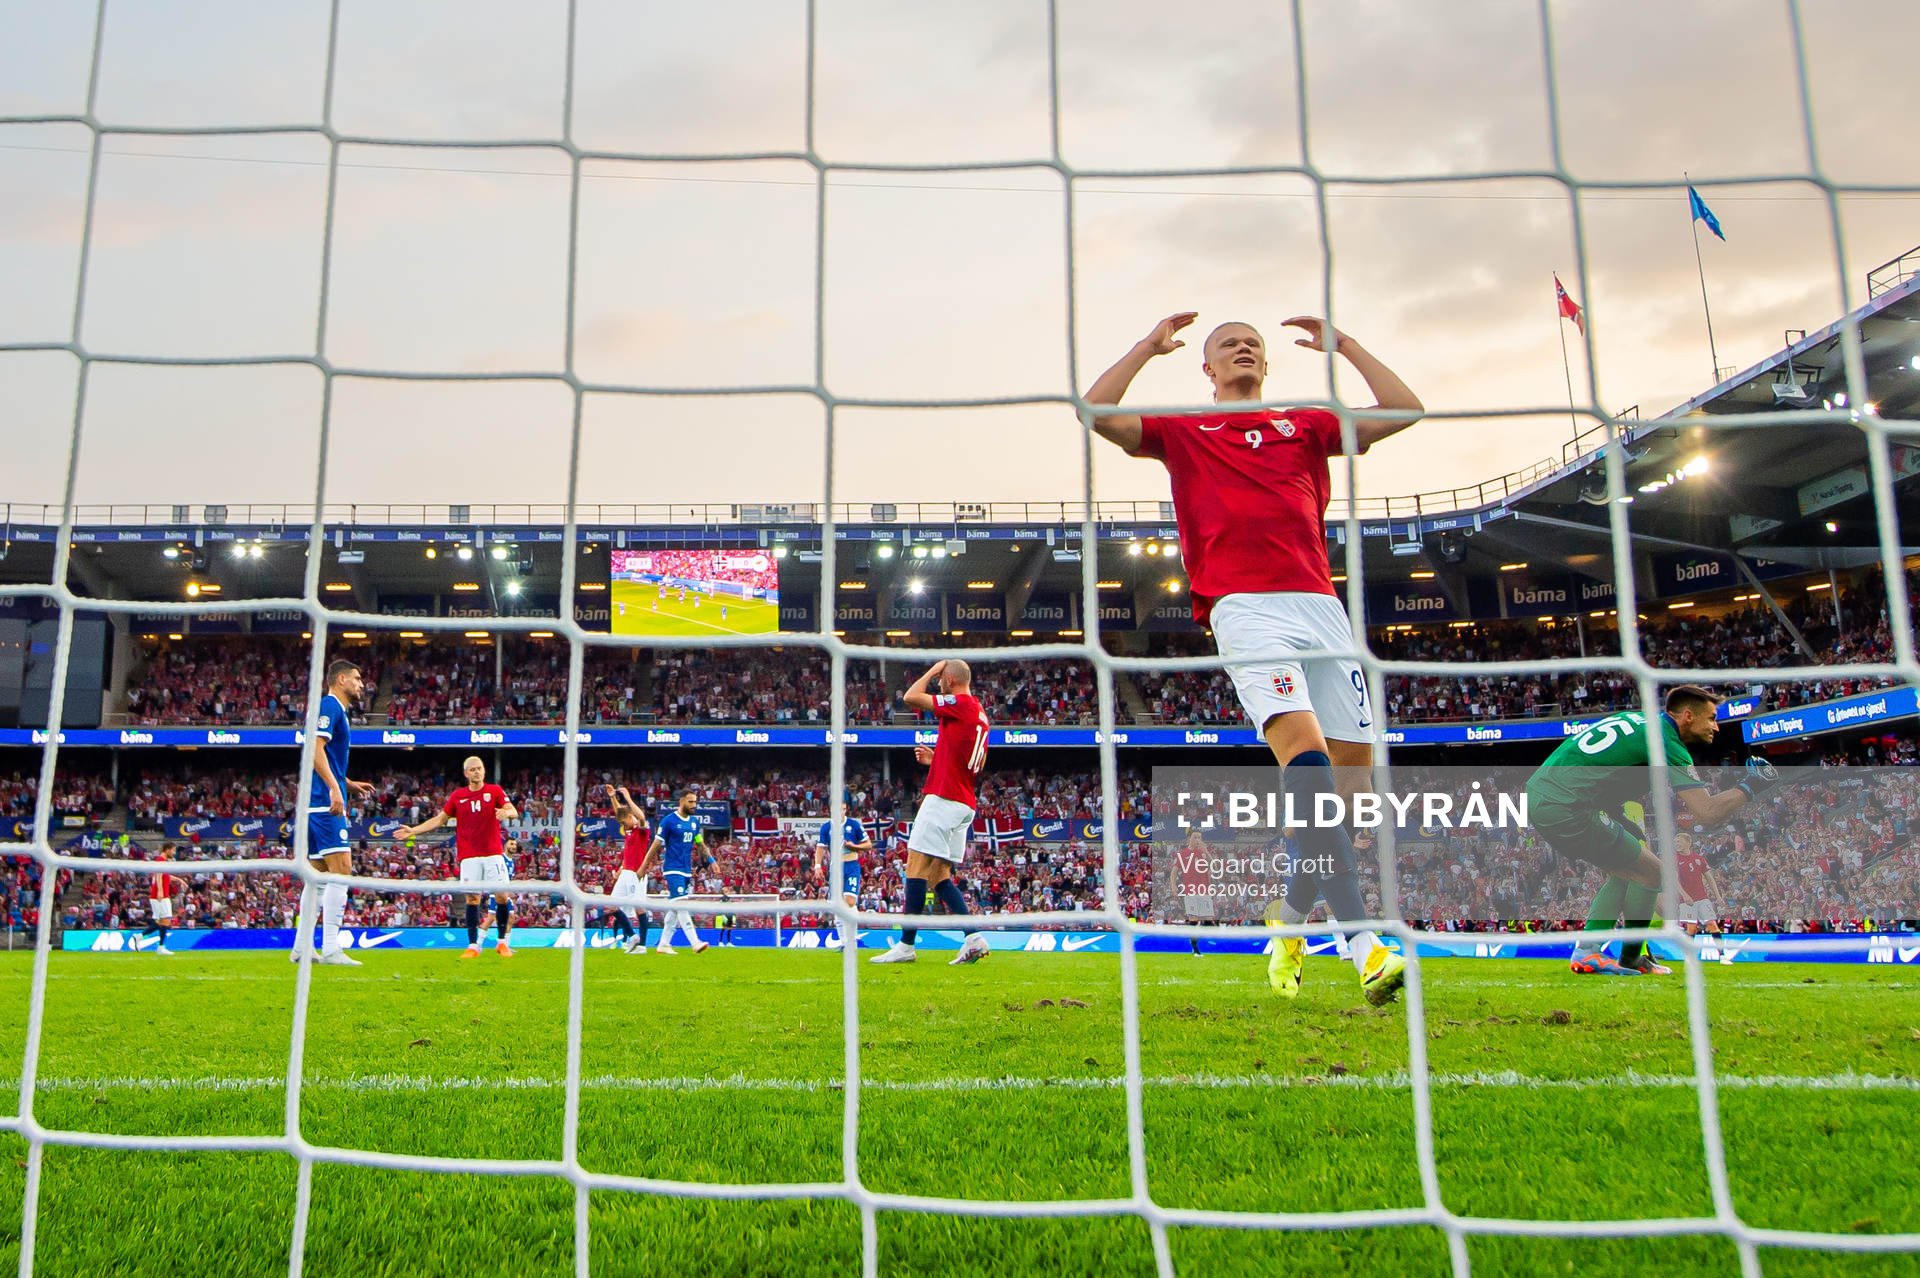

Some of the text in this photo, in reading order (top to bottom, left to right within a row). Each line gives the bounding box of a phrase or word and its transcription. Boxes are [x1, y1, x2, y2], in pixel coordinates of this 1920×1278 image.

[1245, 429, 1262, 449] 9
[1363, 526, 1388, 535] bama
[1434, 520, 1456, 529] bama
[871, 530, 894, 539] bama
[919, 530, 942, 538] bama
[966, 529, 990, 538] bama
[1014, 529, 1038, 538] bama
[1676, 560, 1720, 581] bama
[1513, 587, 1566, 604] bama
[1394, 595, 1445, 611] bama
[781, 607, 808, 619] ma
[890, 603, 936, 619] bama
[956, 603, 1001, 619] bama
[1098, 606, 1130, 619] ama
[1351, 670, 1364, 706] 9
[1729, 703, 1752, 716] bama
[1761, 717, 1804, 734] Norsk Tipping
[120, 730, 153, 744] bama
[208, 730, 240, 744] bama
[383, 730, 415, 744] bama
[471, 730, 503, 744] bama
[648, 730, 680, 744] bama
[736, 730, 769, 744] bama
[1005, 730, 1038, 743] bama
[1186, 731, 1218, 744] bama
[1467, 727, 1501, 740] bama
[470, 800, 481, 812] 14
[1039, 821, 1063, 834] Bendit
[683, 832, 693, 842] 20
